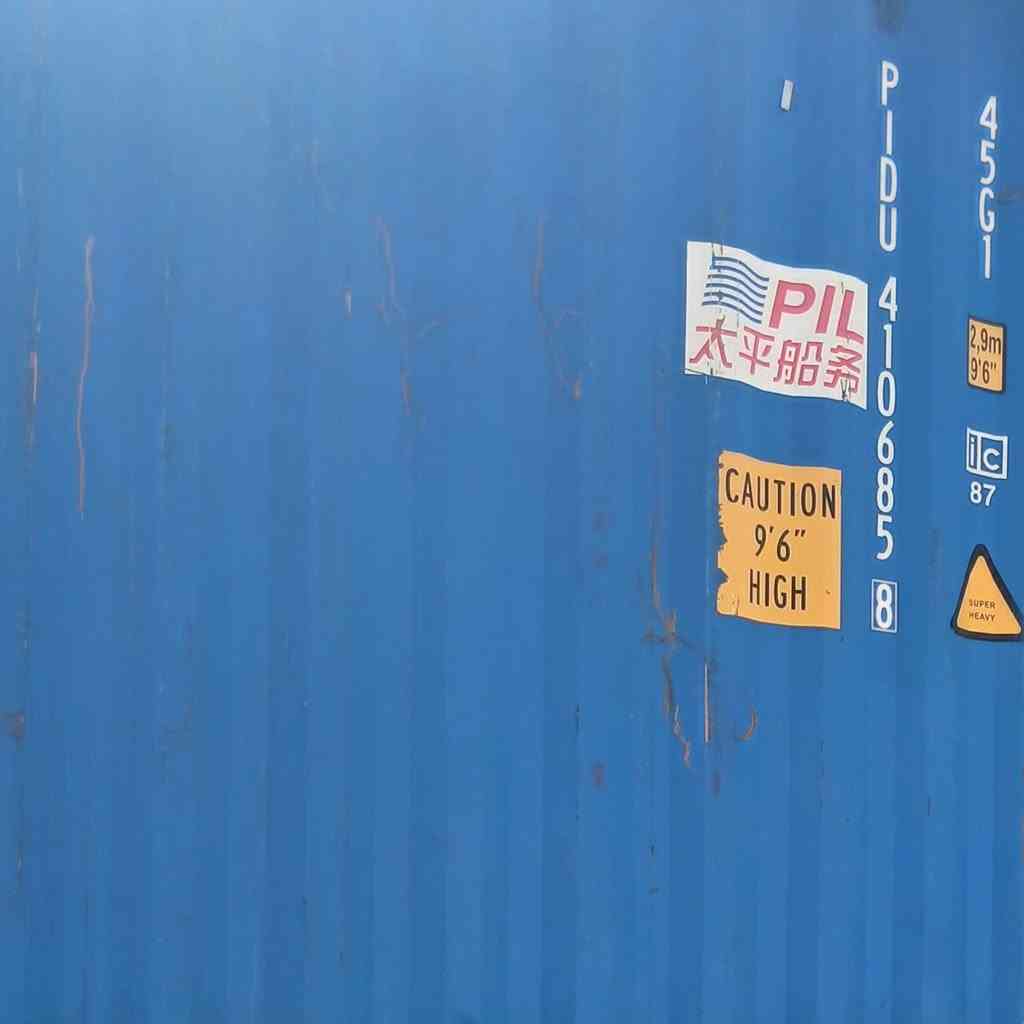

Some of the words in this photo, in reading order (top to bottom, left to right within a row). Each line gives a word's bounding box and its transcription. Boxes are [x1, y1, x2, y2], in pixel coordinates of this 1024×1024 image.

[878, 60, 899, 253] PIDU
[978, 95, 999, 280] 45G1
[768, 279, 865, 344] PIL
[876, 275, 898, 561] 410685
[725, 467, 837, 520] CAUTION
[969, 481, 997, 507] 87
[748, 568, 807, 611] HIGH
[968, 599, 997, 609] SUPER
[968, 611, 997, 622] HEAVY
